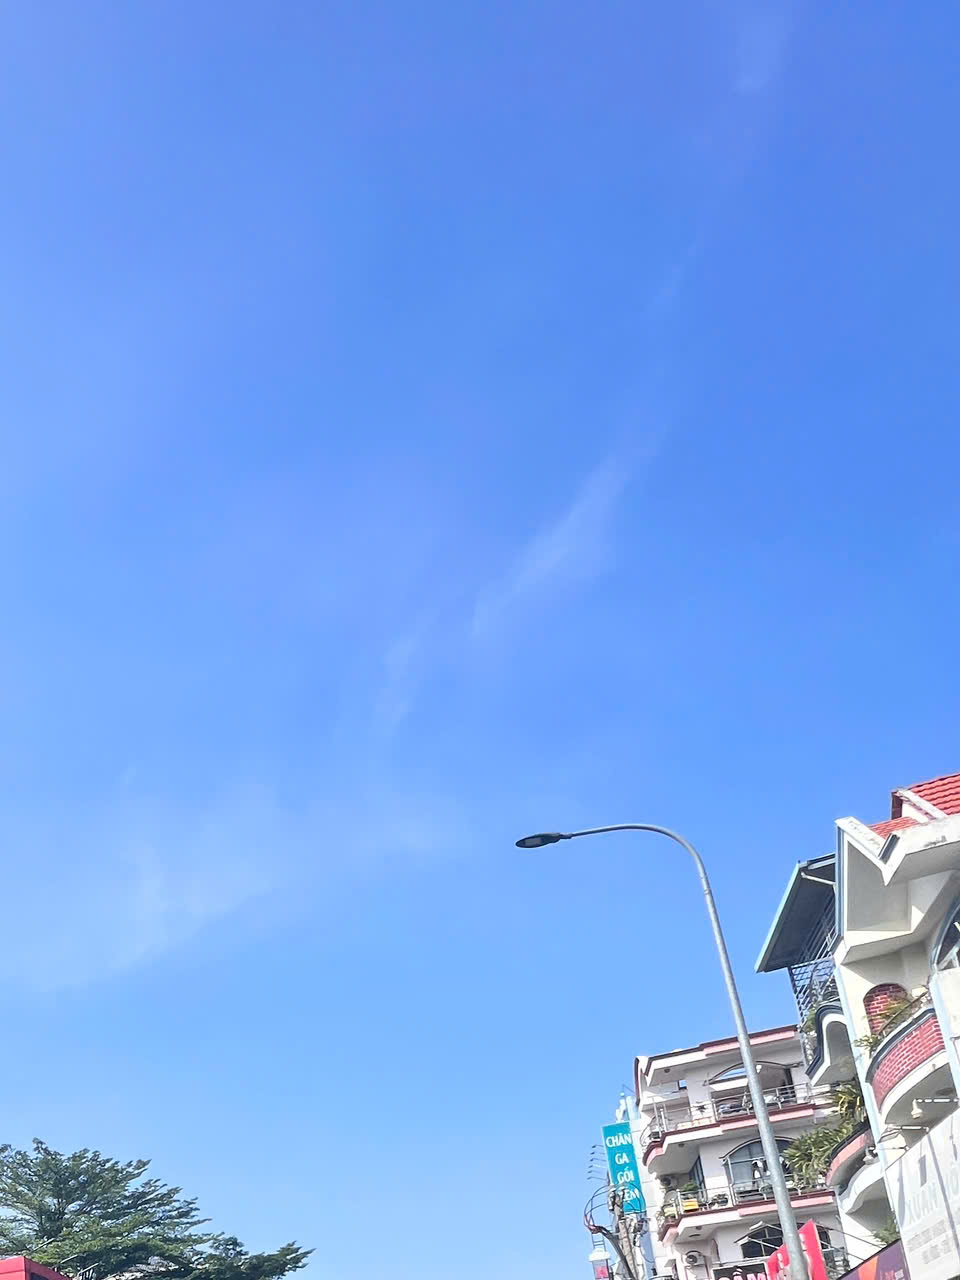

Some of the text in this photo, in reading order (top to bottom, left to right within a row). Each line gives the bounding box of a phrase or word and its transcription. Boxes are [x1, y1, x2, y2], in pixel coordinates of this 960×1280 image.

[606, 1133, 632, 1147] CHĂN
[615, 1152, 629, 1165] GA
[617, 1166, 635, 1184] GỐI
